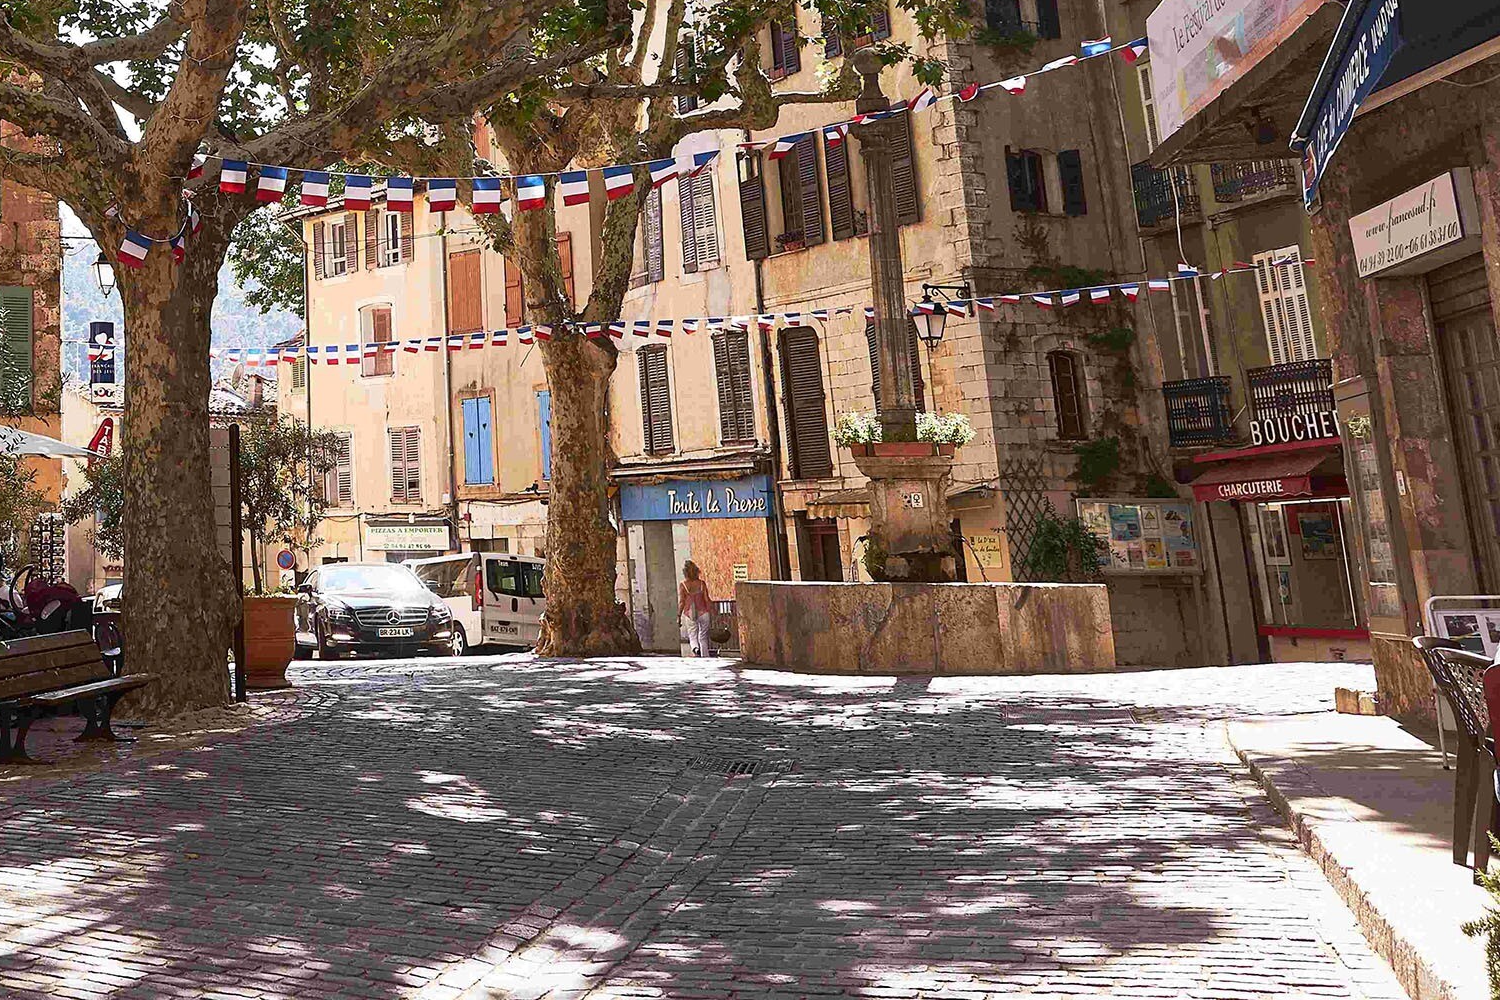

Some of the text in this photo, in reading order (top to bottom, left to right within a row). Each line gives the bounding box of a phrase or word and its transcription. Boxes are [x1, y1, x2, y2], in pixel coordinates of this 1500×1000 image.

[1172, 26, 1185, 53] Le
[1336, 32, 1371, 127] COMMERCE
[1387, 246, 1395, 263] 22
[1394, 243, 1404, 259] 00
[1447, 221, 1458, 238] 00
[668, 487, 767, 514] Toute la Presse
[1218, 479, 1284, 497] CHARCUTERIE
